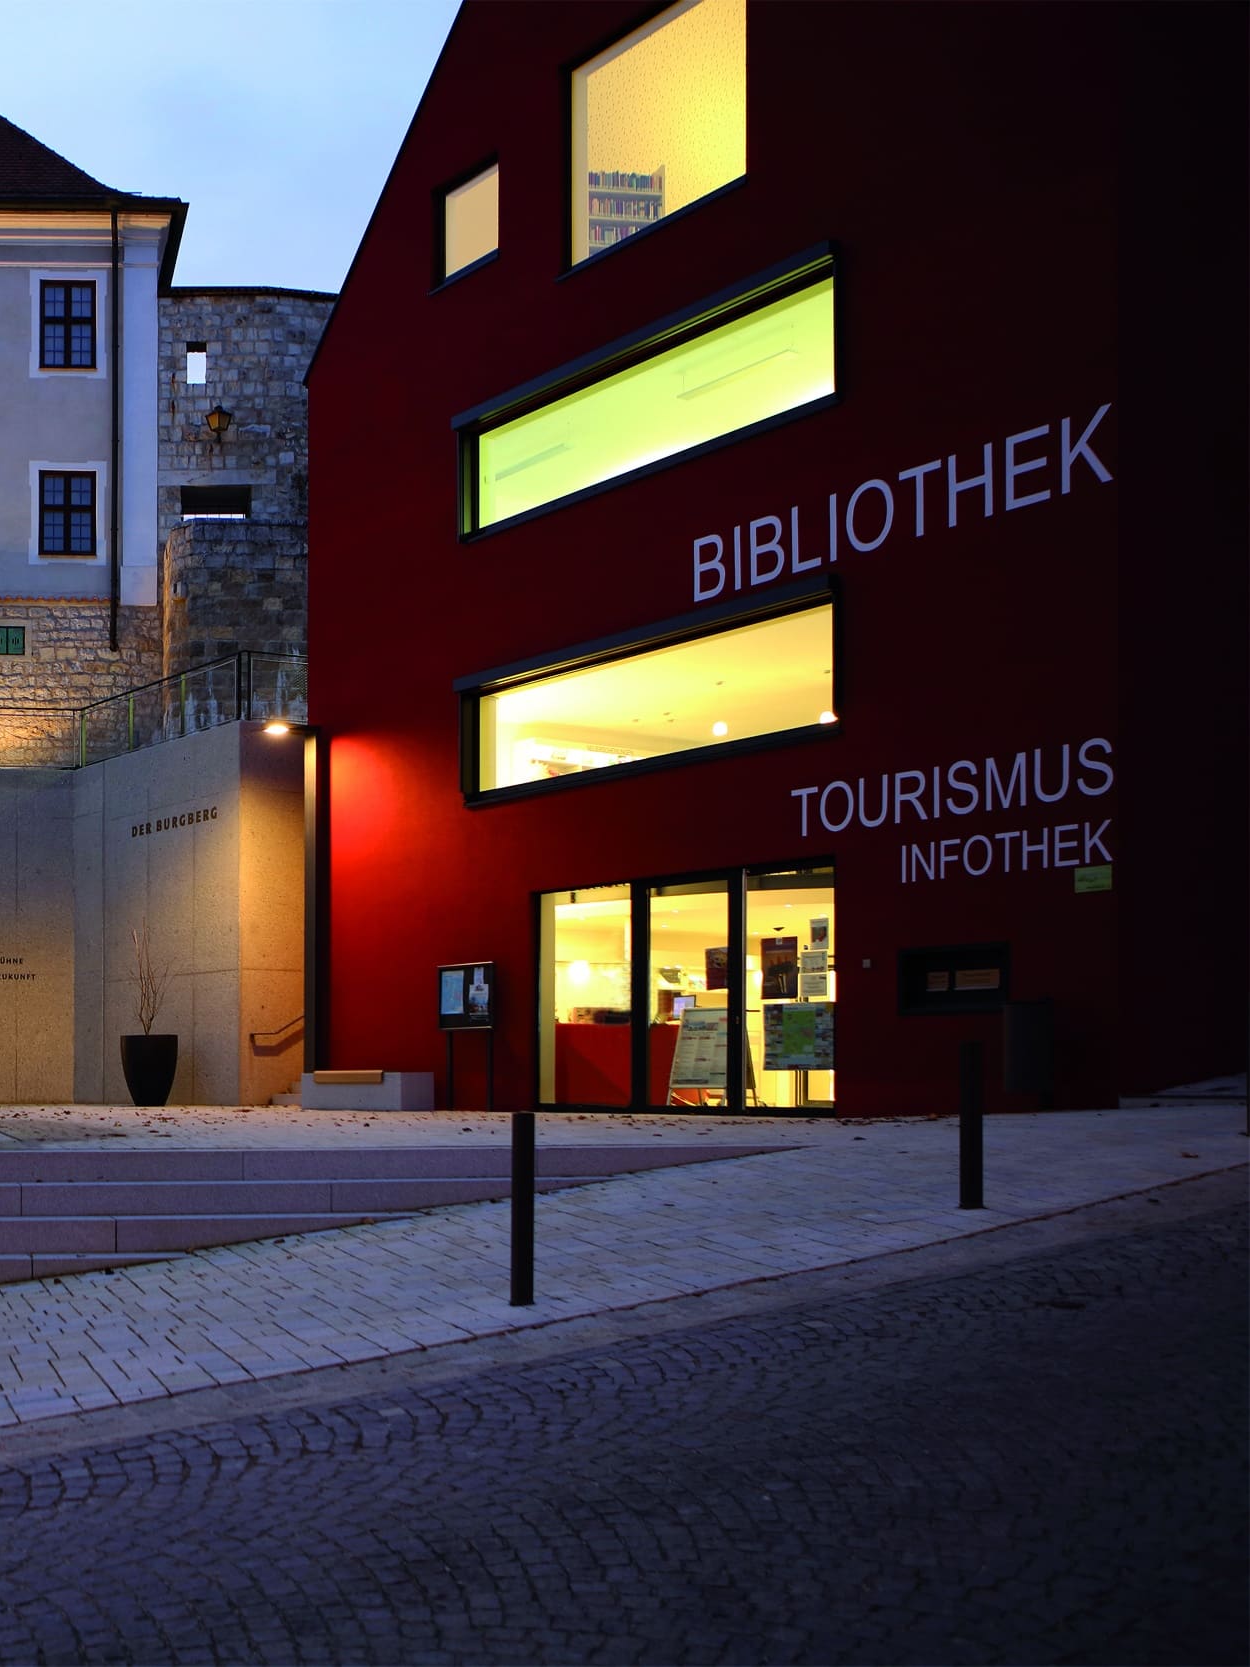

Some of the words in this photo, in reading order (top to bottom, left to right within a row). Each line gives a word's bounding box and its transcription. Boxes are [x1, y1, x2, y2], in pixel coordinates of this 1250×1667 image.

[693, 402, 1114, 603] BIBLIOTHEK
[132, 822, 152, 838] DER
[156, 806, 218, 832] BURGBERG
[791, 737, 1114, 838] TOURISMUS
[900, 819, 1113, 884] INFOTHEK
